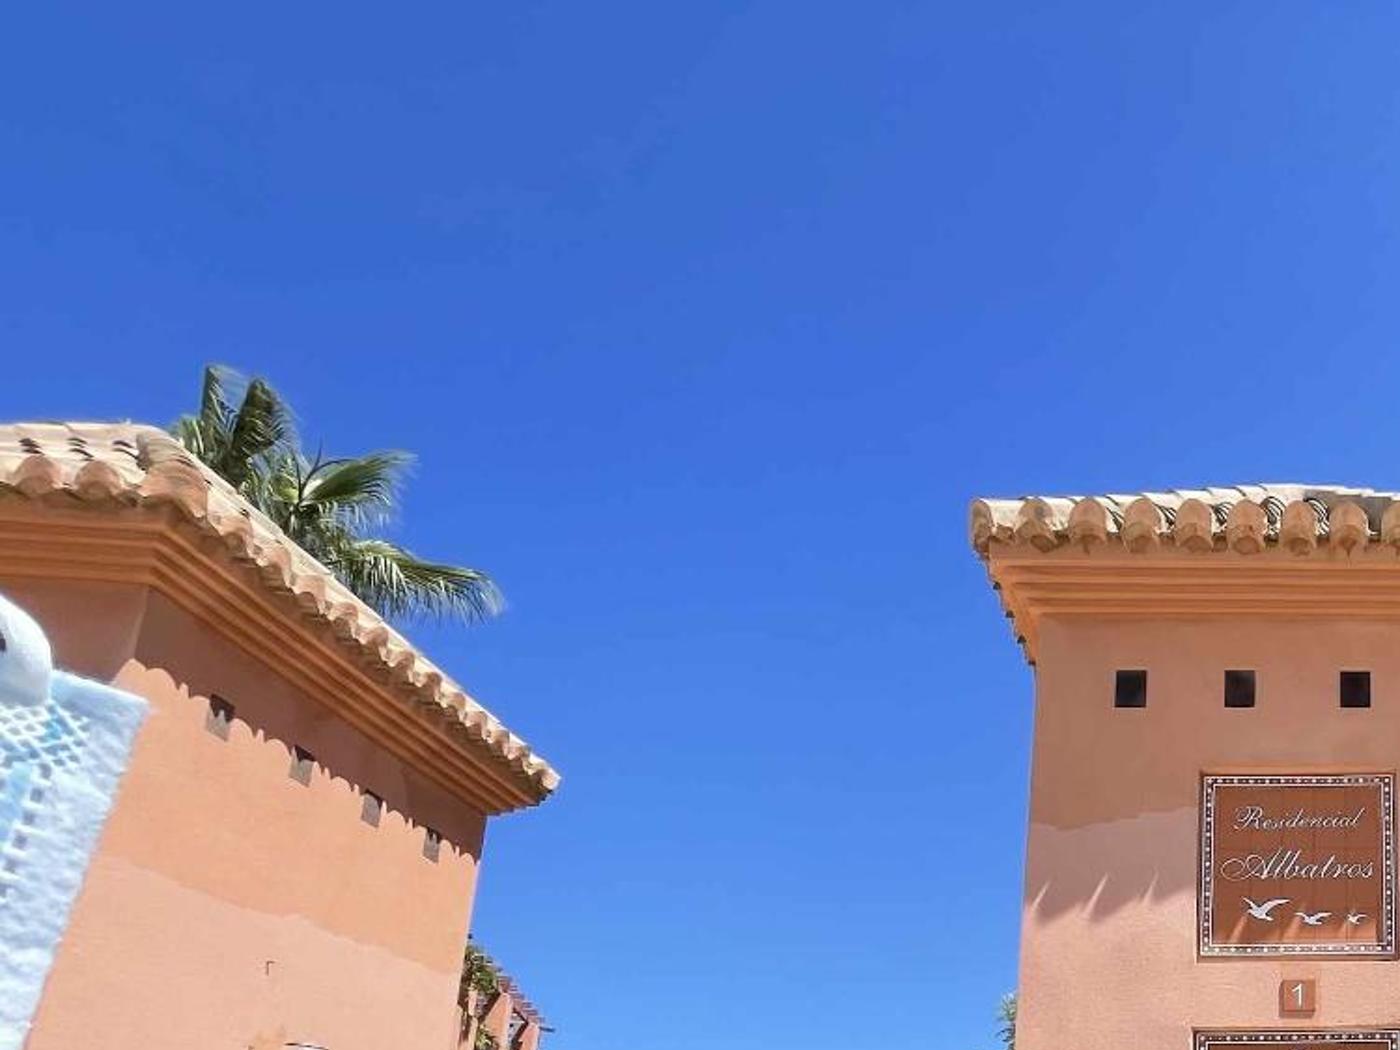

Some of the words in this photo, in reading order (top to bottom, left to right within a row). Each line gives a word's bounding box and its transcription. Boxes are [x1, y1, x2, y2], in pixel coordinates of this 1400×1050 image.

[1233, 806, 1366, 832] Residencial
[1220, 848, 1375, 882] Albatros
[1292, 982, 1304, 1008] 1
